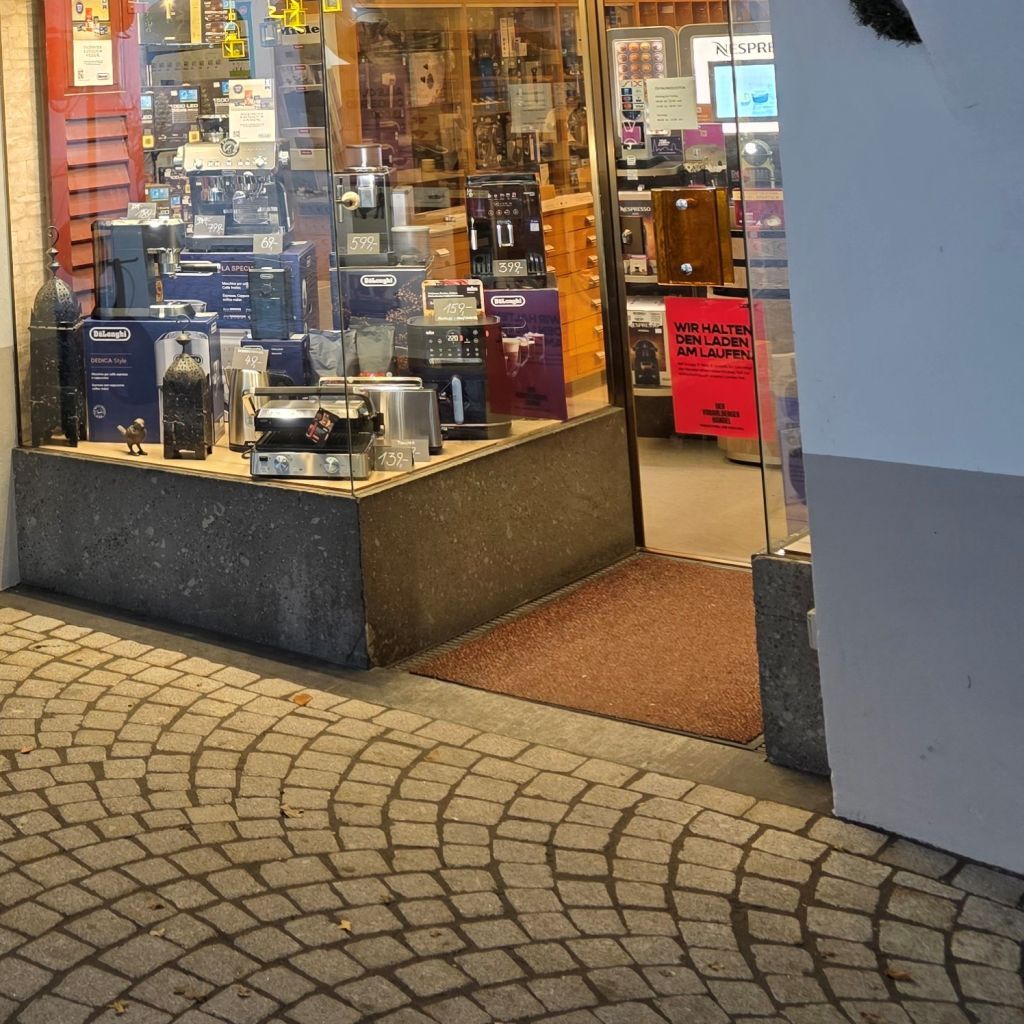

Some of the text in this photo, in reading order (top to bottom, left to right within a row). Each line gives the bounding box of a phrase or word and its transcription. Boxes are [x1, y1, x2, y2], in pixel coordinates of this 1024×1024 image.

[261, 236, 280, 250] 69,-
[350, 236, 378, 251] 599,-
[498, 261, 524, 274] 399,-
[443, 302, 473, 316] 159,-
[674, 322, 752, 336] WIR HALTEN
[676, 334, 749, 348] DEN LADEN
[677, 347, 698, 357] AM
[113, 357, 127, 365] Style
[244, 355, 264, 369] 49,-
[378, 451, 409, 469] 139,-
